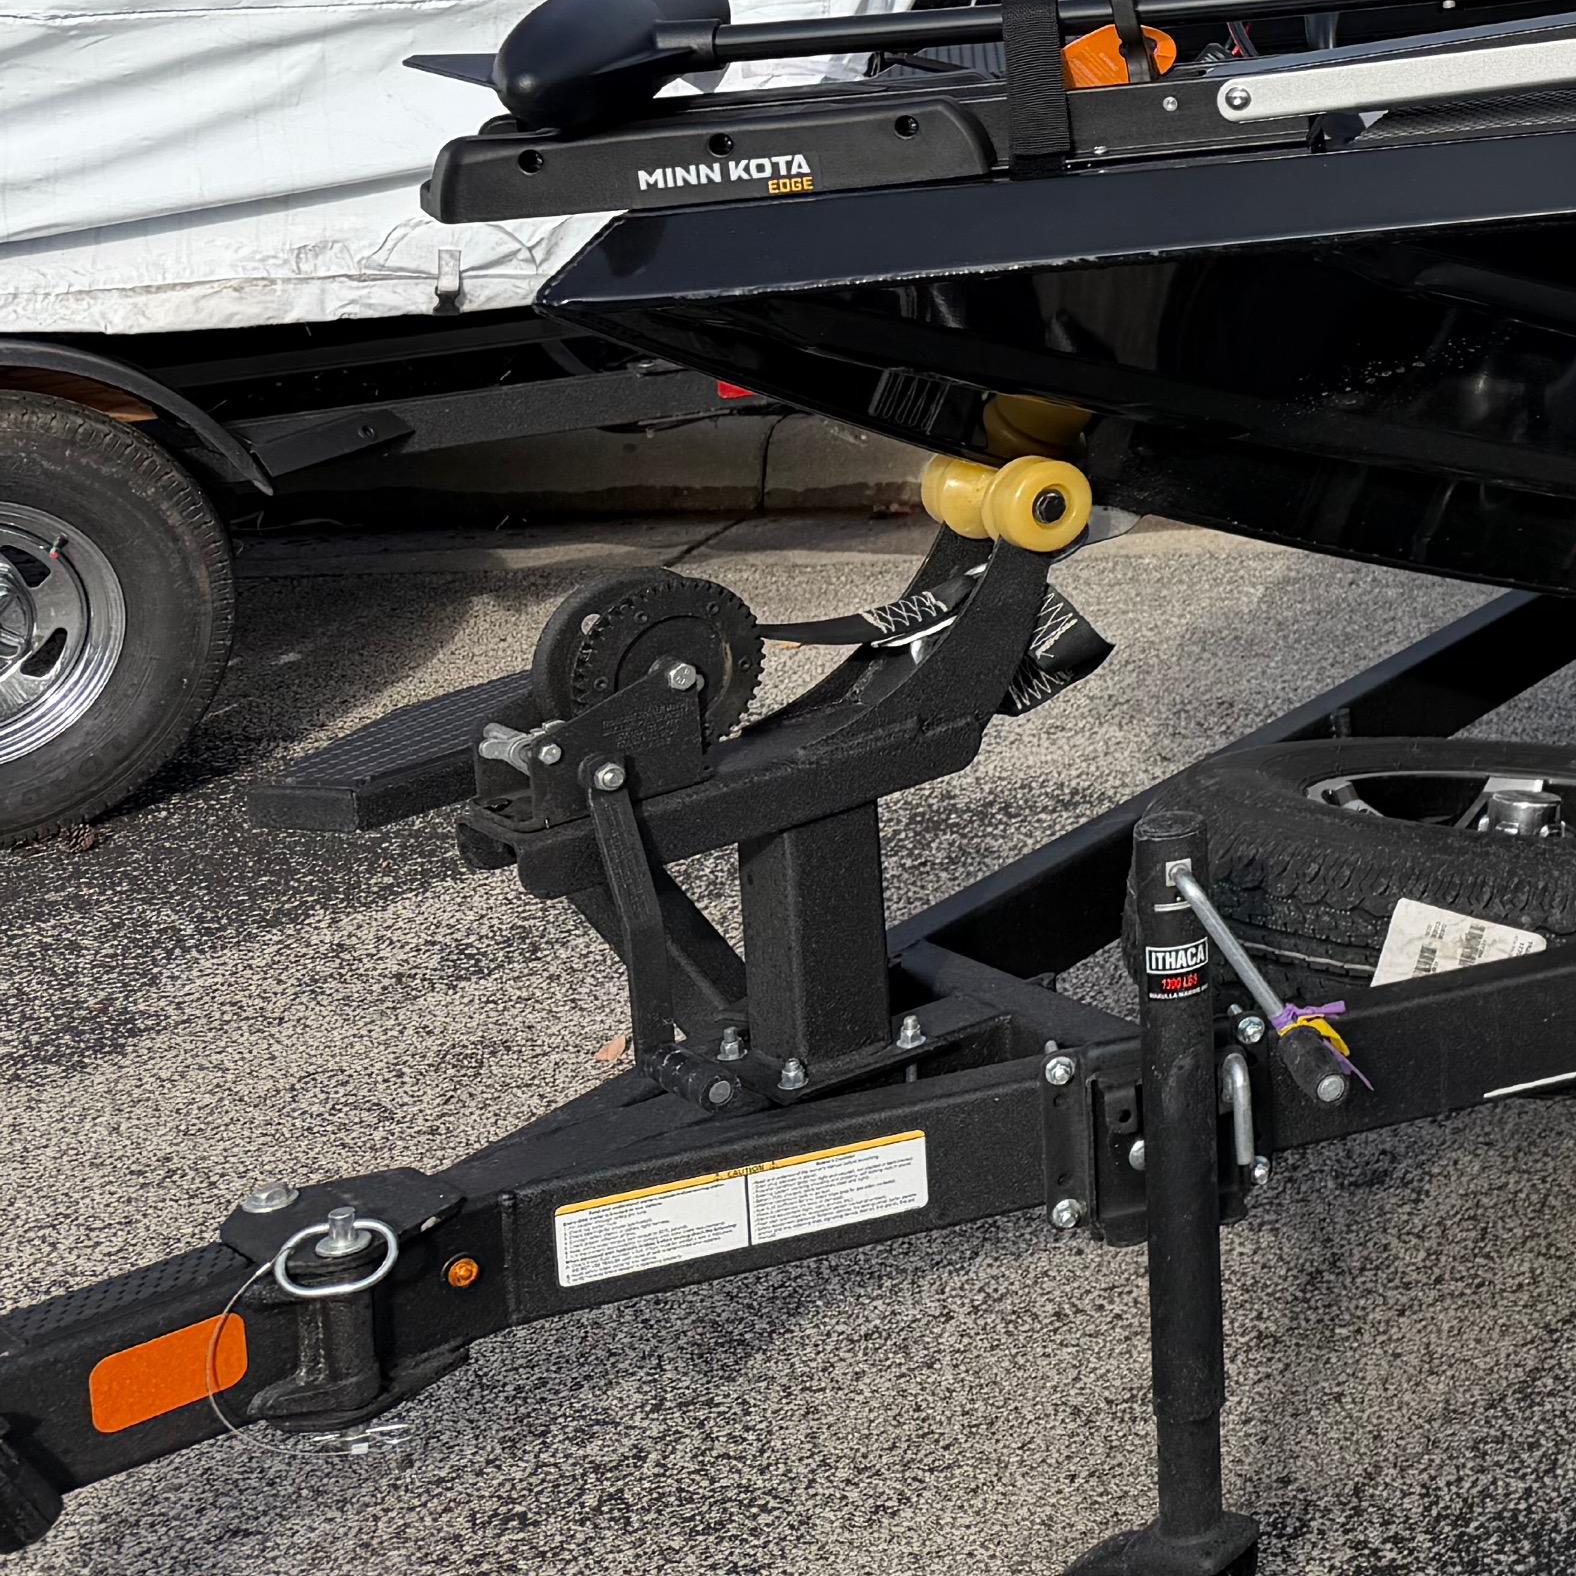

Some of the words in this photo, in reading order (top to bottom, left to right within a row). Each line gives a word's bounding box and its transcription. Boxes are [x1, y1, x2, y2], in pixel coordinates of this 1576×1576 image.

[638, 162, 722, 191] MINN
[728, 154, 811, 182] KOTA
[768, 176, 814, 194] EDGE
[1151, 944, 1205, 970] ITHACA
